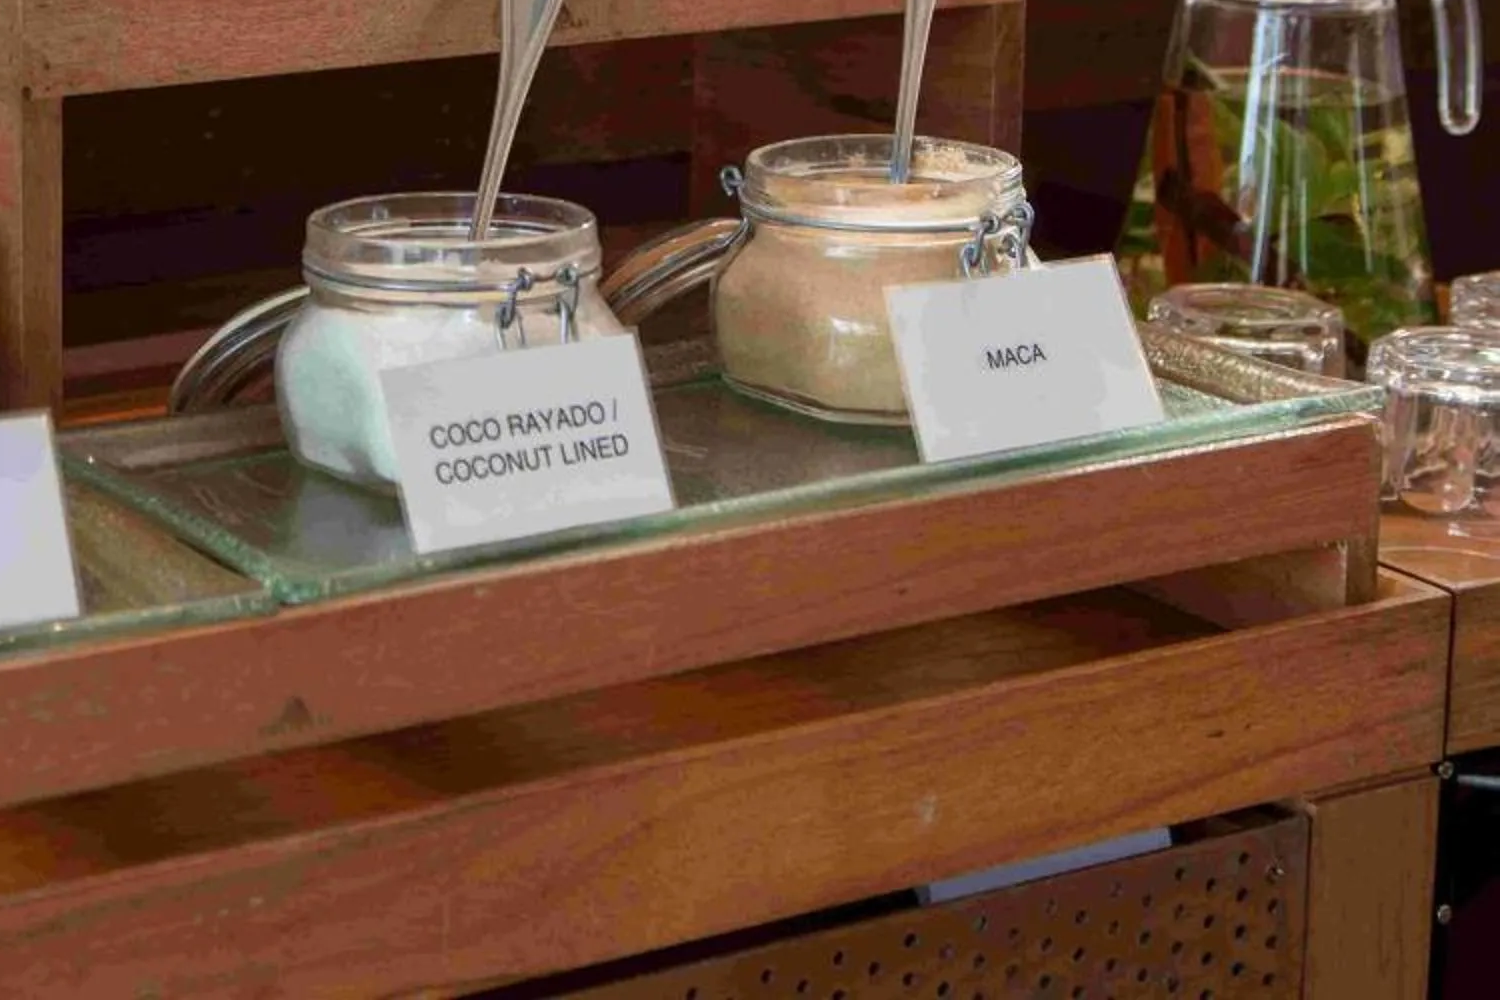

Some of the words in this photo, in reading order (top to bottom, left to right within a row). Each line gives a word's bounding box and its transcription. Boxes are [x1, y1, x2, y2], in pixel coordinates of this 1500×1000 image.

[986, 343, 1047, 370] MACA
[429, 416, 501, 450] COCO
[507, 401, 606, 437] RAYADO
[435, 445, 553, 485] COCONUT
[560, 434, 630, 466] LINED
